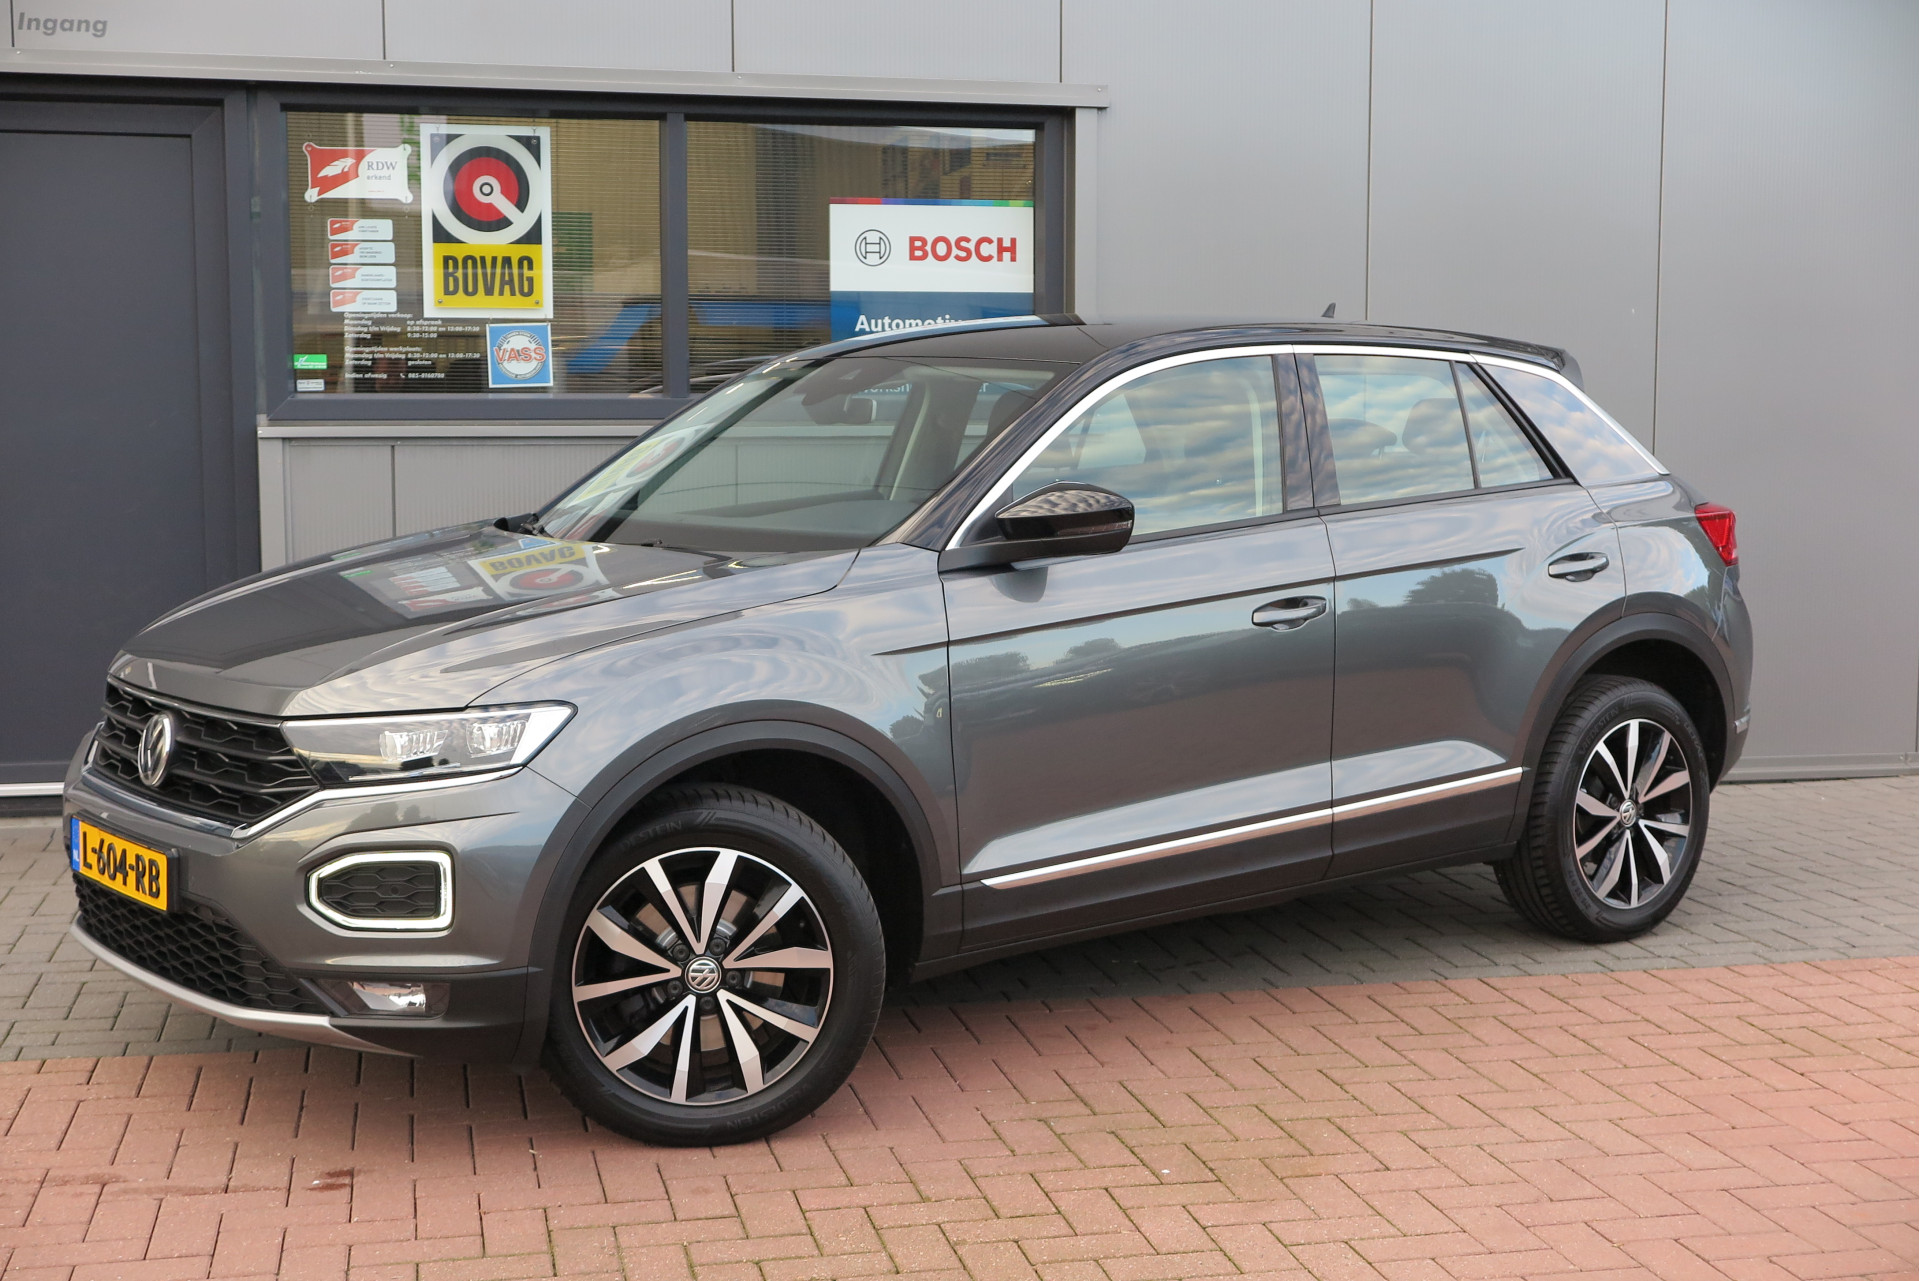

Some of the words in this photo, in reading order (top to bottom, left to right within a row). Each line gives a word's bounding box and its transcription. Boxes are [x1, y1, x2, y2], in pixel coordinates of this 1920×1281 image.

[17, 12, 108, 38] Ingang
[366, 161, 397, 171] RDW
[908, 236, 1017, 262] BOSCH
[442, 255, 534, 297] BOVAG
[855, 314, 963, 332] Automoti
[494, 346, 546, 363] VASS
[83, 831, 161, 899] L-604-RB
